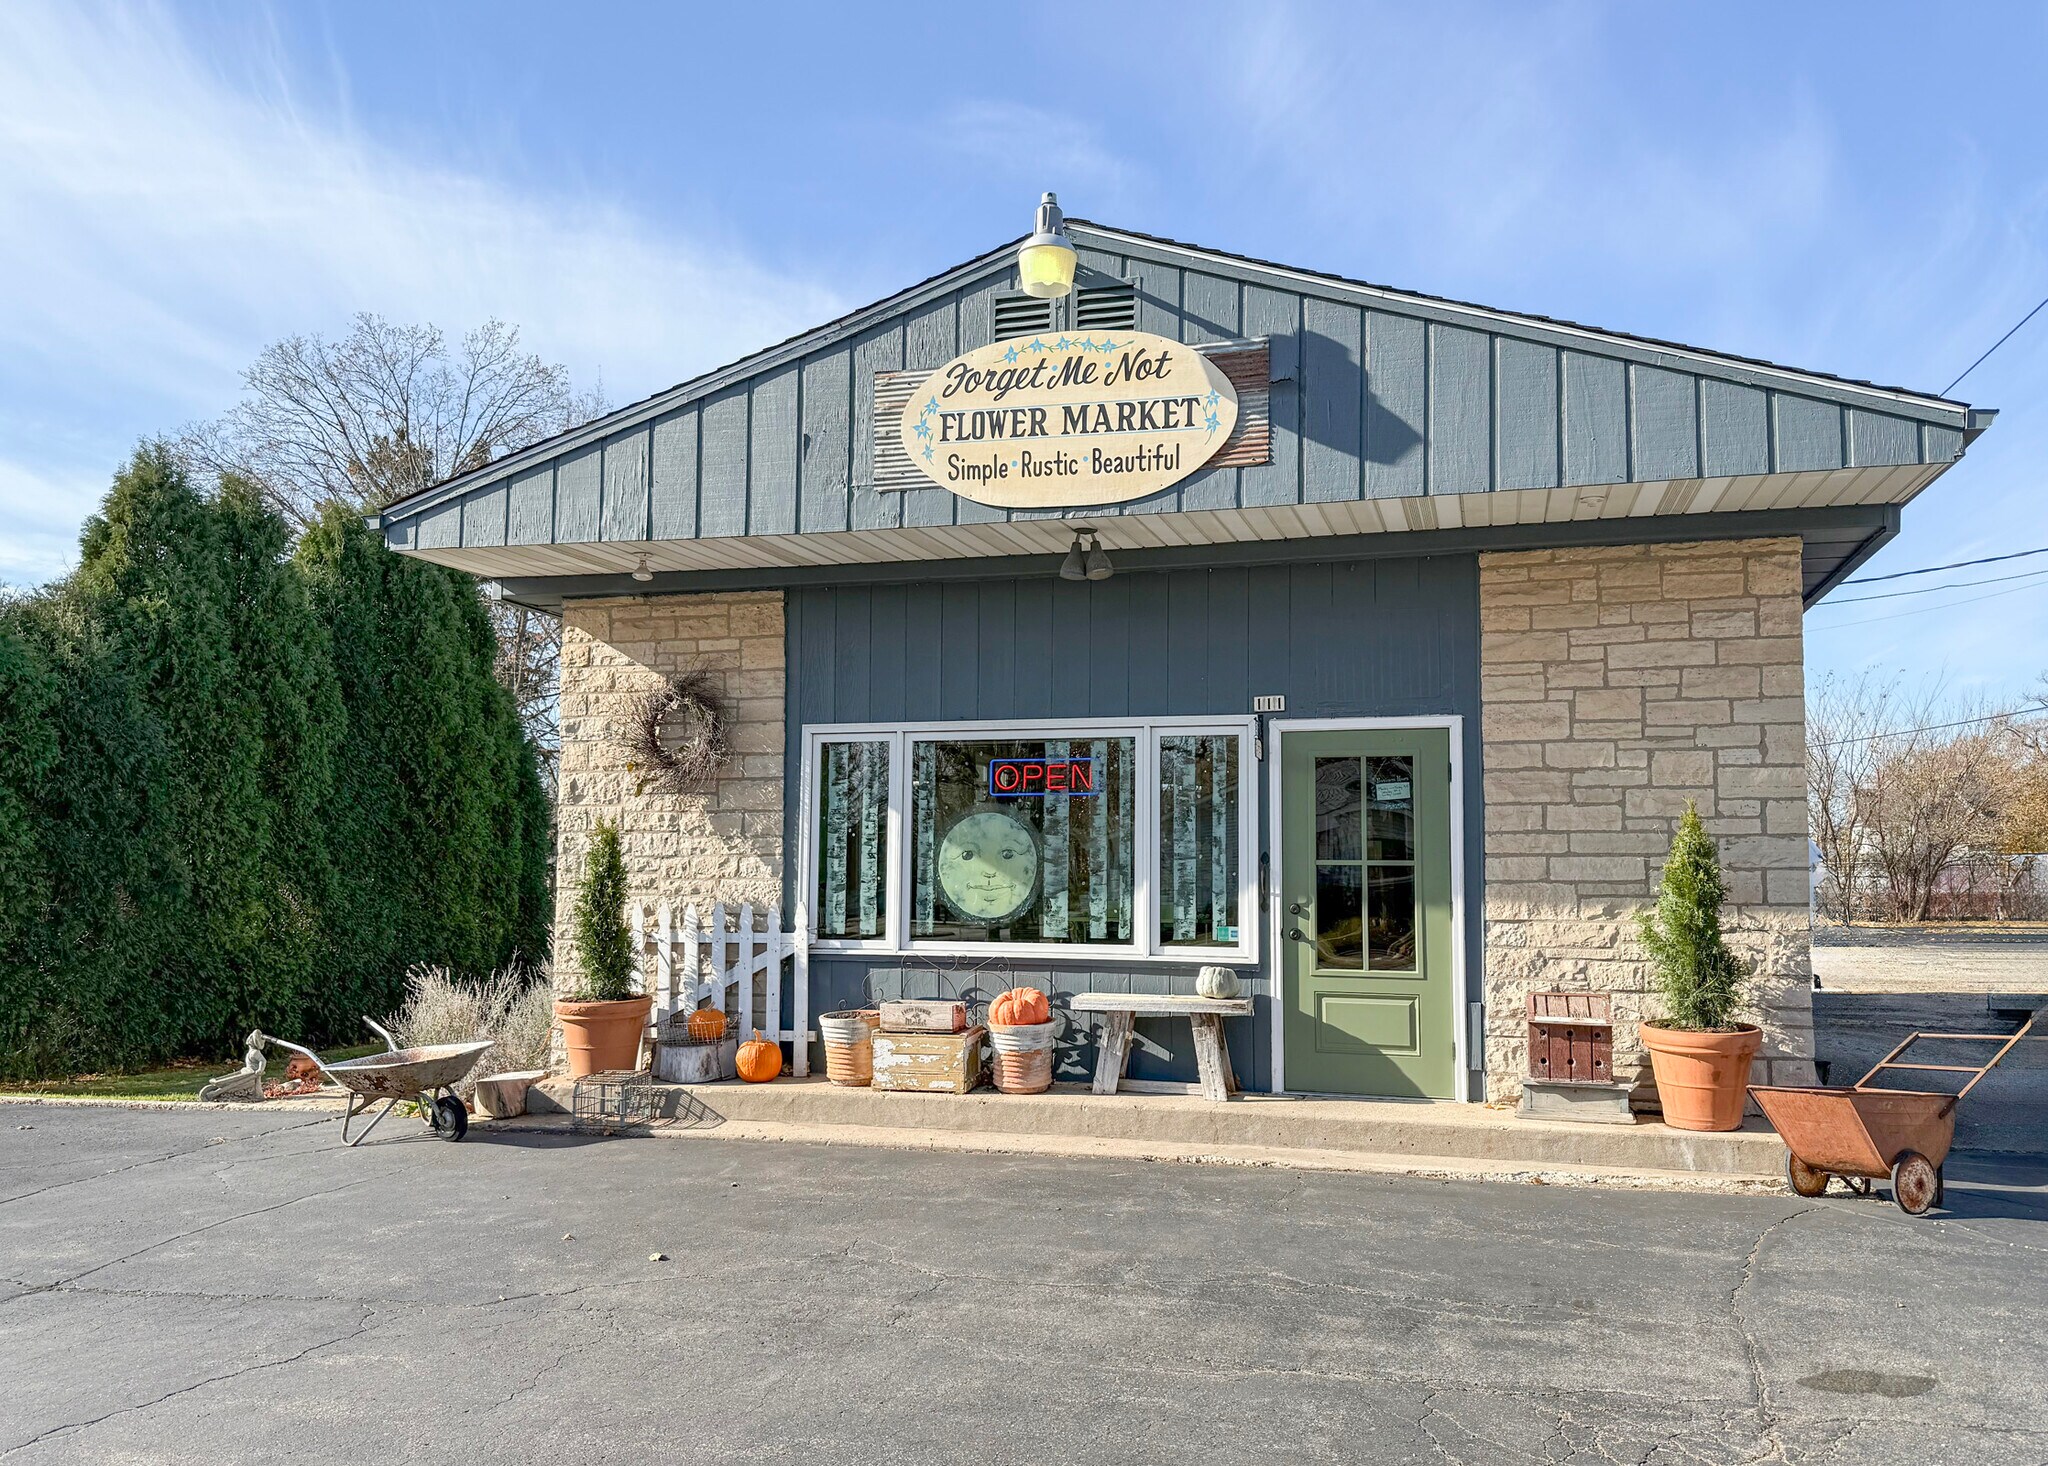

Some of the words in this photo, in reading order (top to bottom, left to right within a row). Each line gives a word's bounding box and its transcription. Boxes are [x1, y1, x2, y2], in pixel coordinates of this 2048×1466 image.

[942, 357, 1049, 401] Forget
[1047, 355, 1098, 388] Me
[1104, 347, 1174, 387] Not
[939, 406, 1049, 442] FLOWER
[1061, 397, 1201, 436] MARKET
[947, 453, 1009, 487] Simple
[1021, 450, 1079, 478] Rustic
[1092, 443, 1181, 475] Beautiful
[1257, 697, 1282, 710] 111
[994, 763, 1093, 791] OPEN
